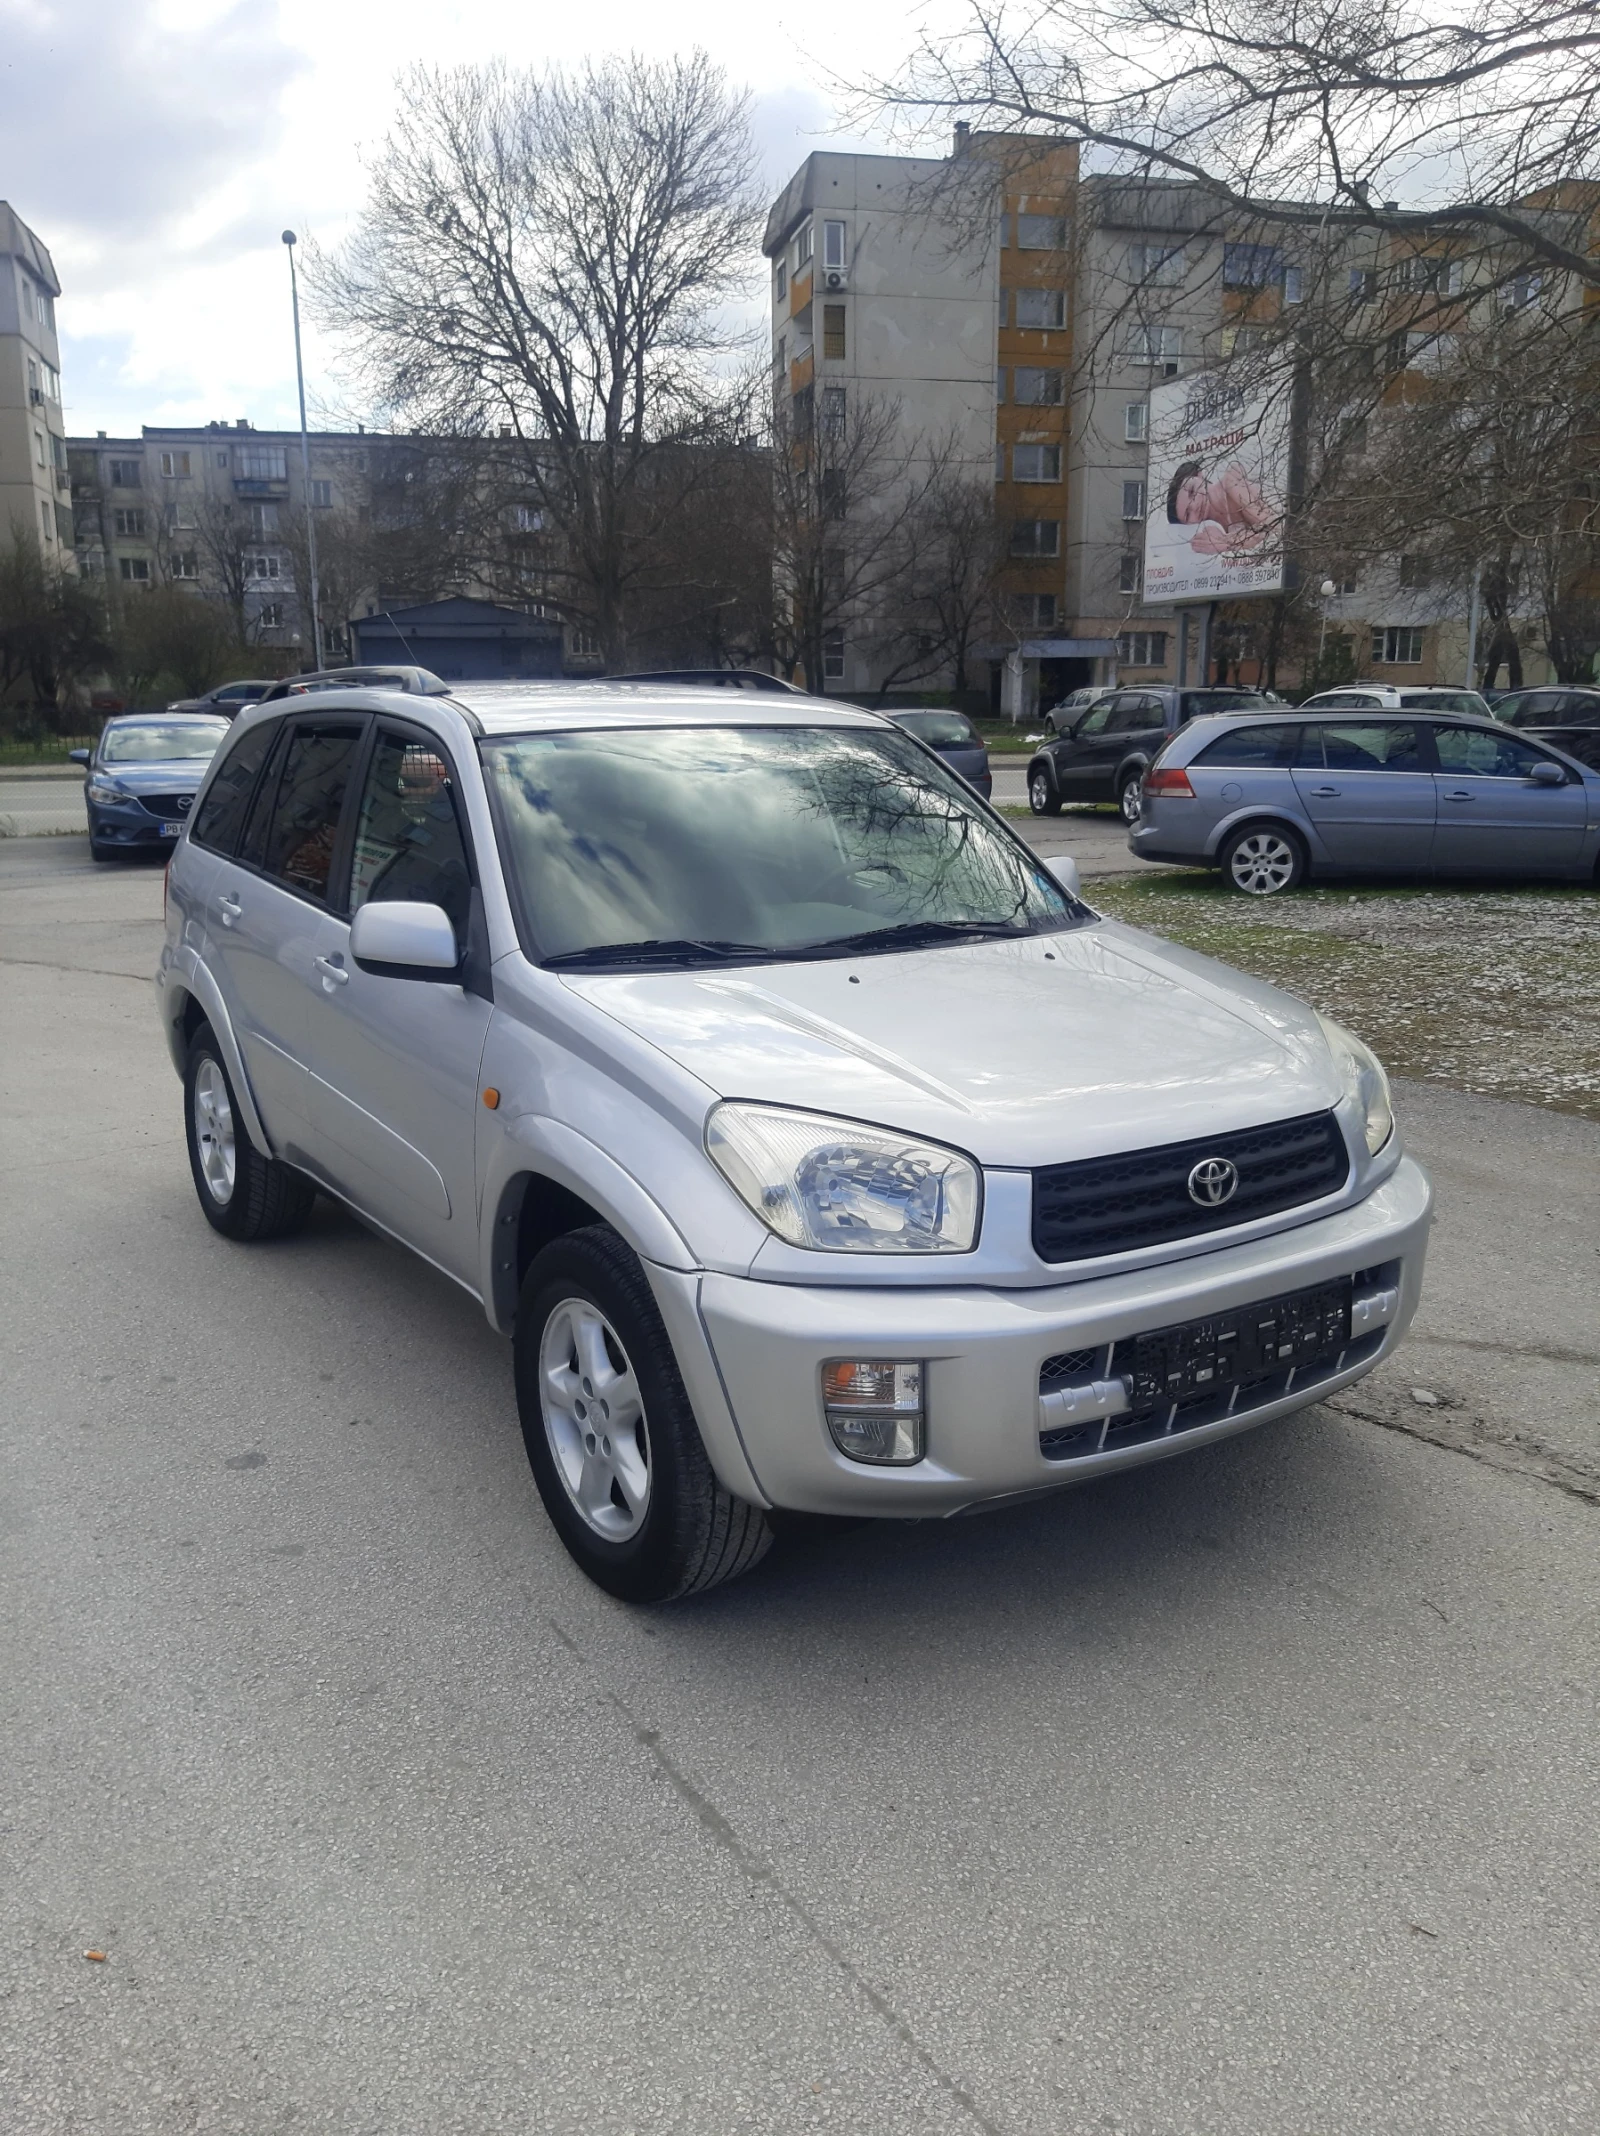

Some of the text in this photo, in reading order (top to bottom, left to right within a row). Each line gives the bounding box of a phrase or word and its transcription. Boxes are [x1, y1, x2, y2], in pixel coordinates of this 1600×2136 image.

[1185, 429, 1244, 457] МАТРАЦИ
[1146, 566, 1174, 580] ПЛОВДИВ
[1146, 580, 1189, 594] ПРОИЗВОДИТЕЛ
